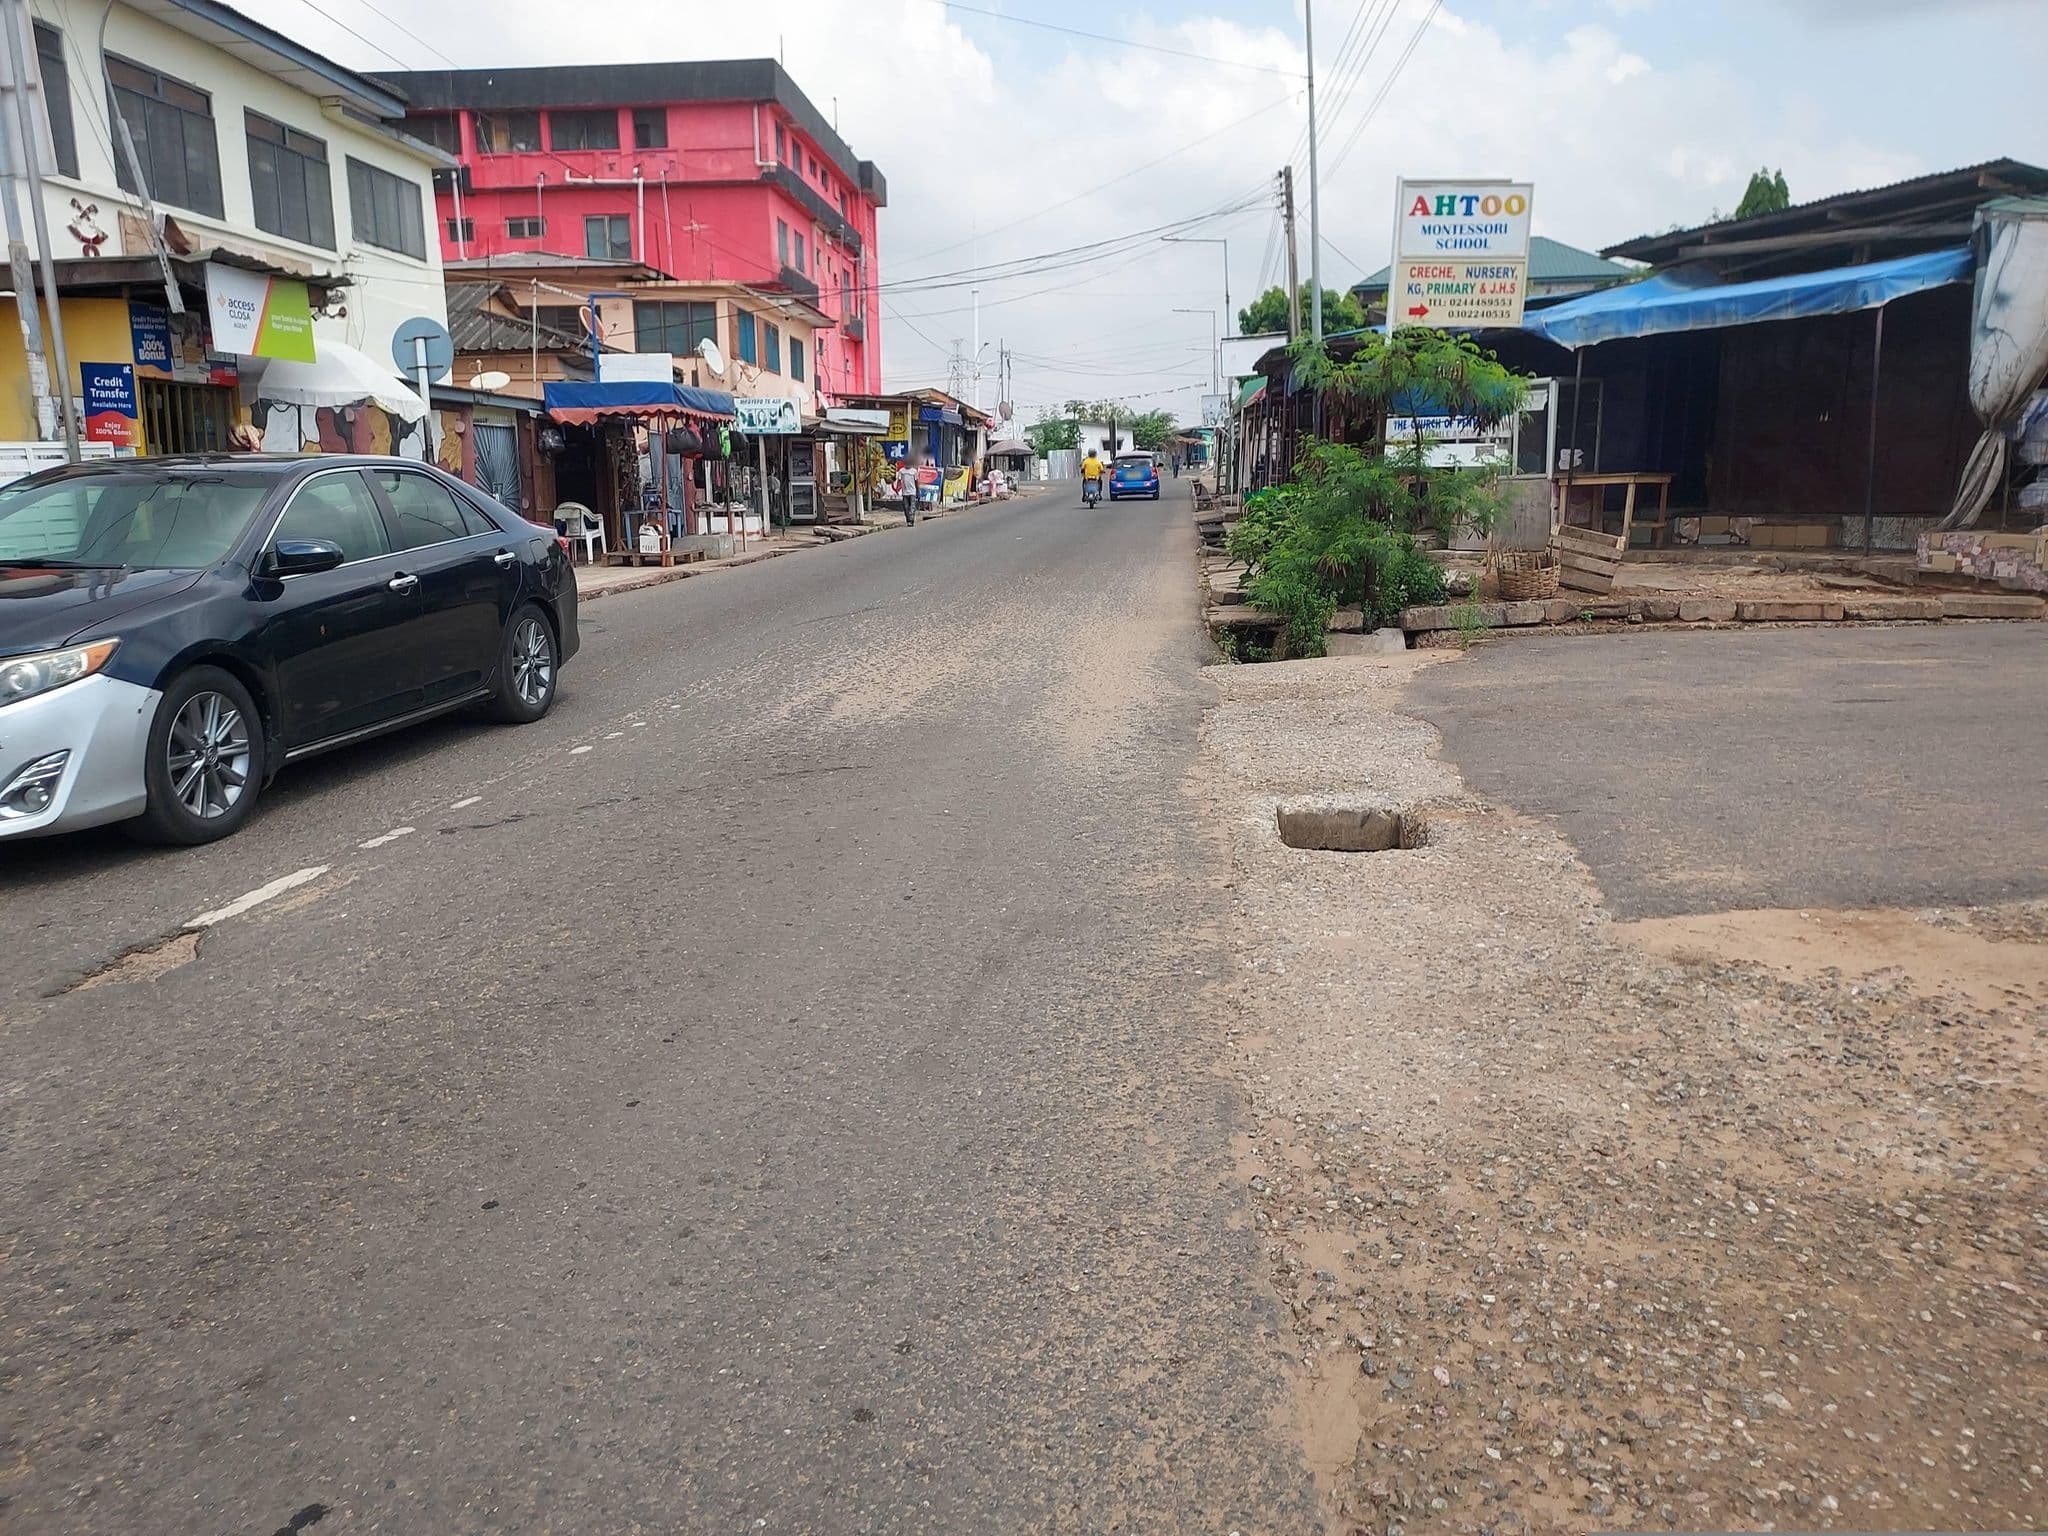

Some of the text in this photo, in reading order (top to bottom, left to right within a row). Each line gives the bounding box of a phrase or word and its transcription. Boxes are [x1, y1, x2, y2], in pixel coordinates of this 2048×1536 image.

[1408, 194, 1526, 217] AHTOO
[1421, 223, 1508, 236] MONTESSORI
[1435, 238, 1489, 250] SCHOOL
[1409, 266, 1518, 280] CRECHE, NURSERY,
[1407, 283, 1425, 297] KG,
[1426, 283, 1477, 295] PRIMARY
[1479, 283, 1487, 294] &
[228, 298, 256, 312] access
[229, 309, 252, 321] CLOSA
[141, 340, 165, 351] 100%
[94, 377, 123, 388] Credit
[90, 388, 129, 399] Transfer
[92, 401, 116, 409] Available
[104, 421, 121, 430] Enjoy
[1393, 419, 1408, 431] THE
